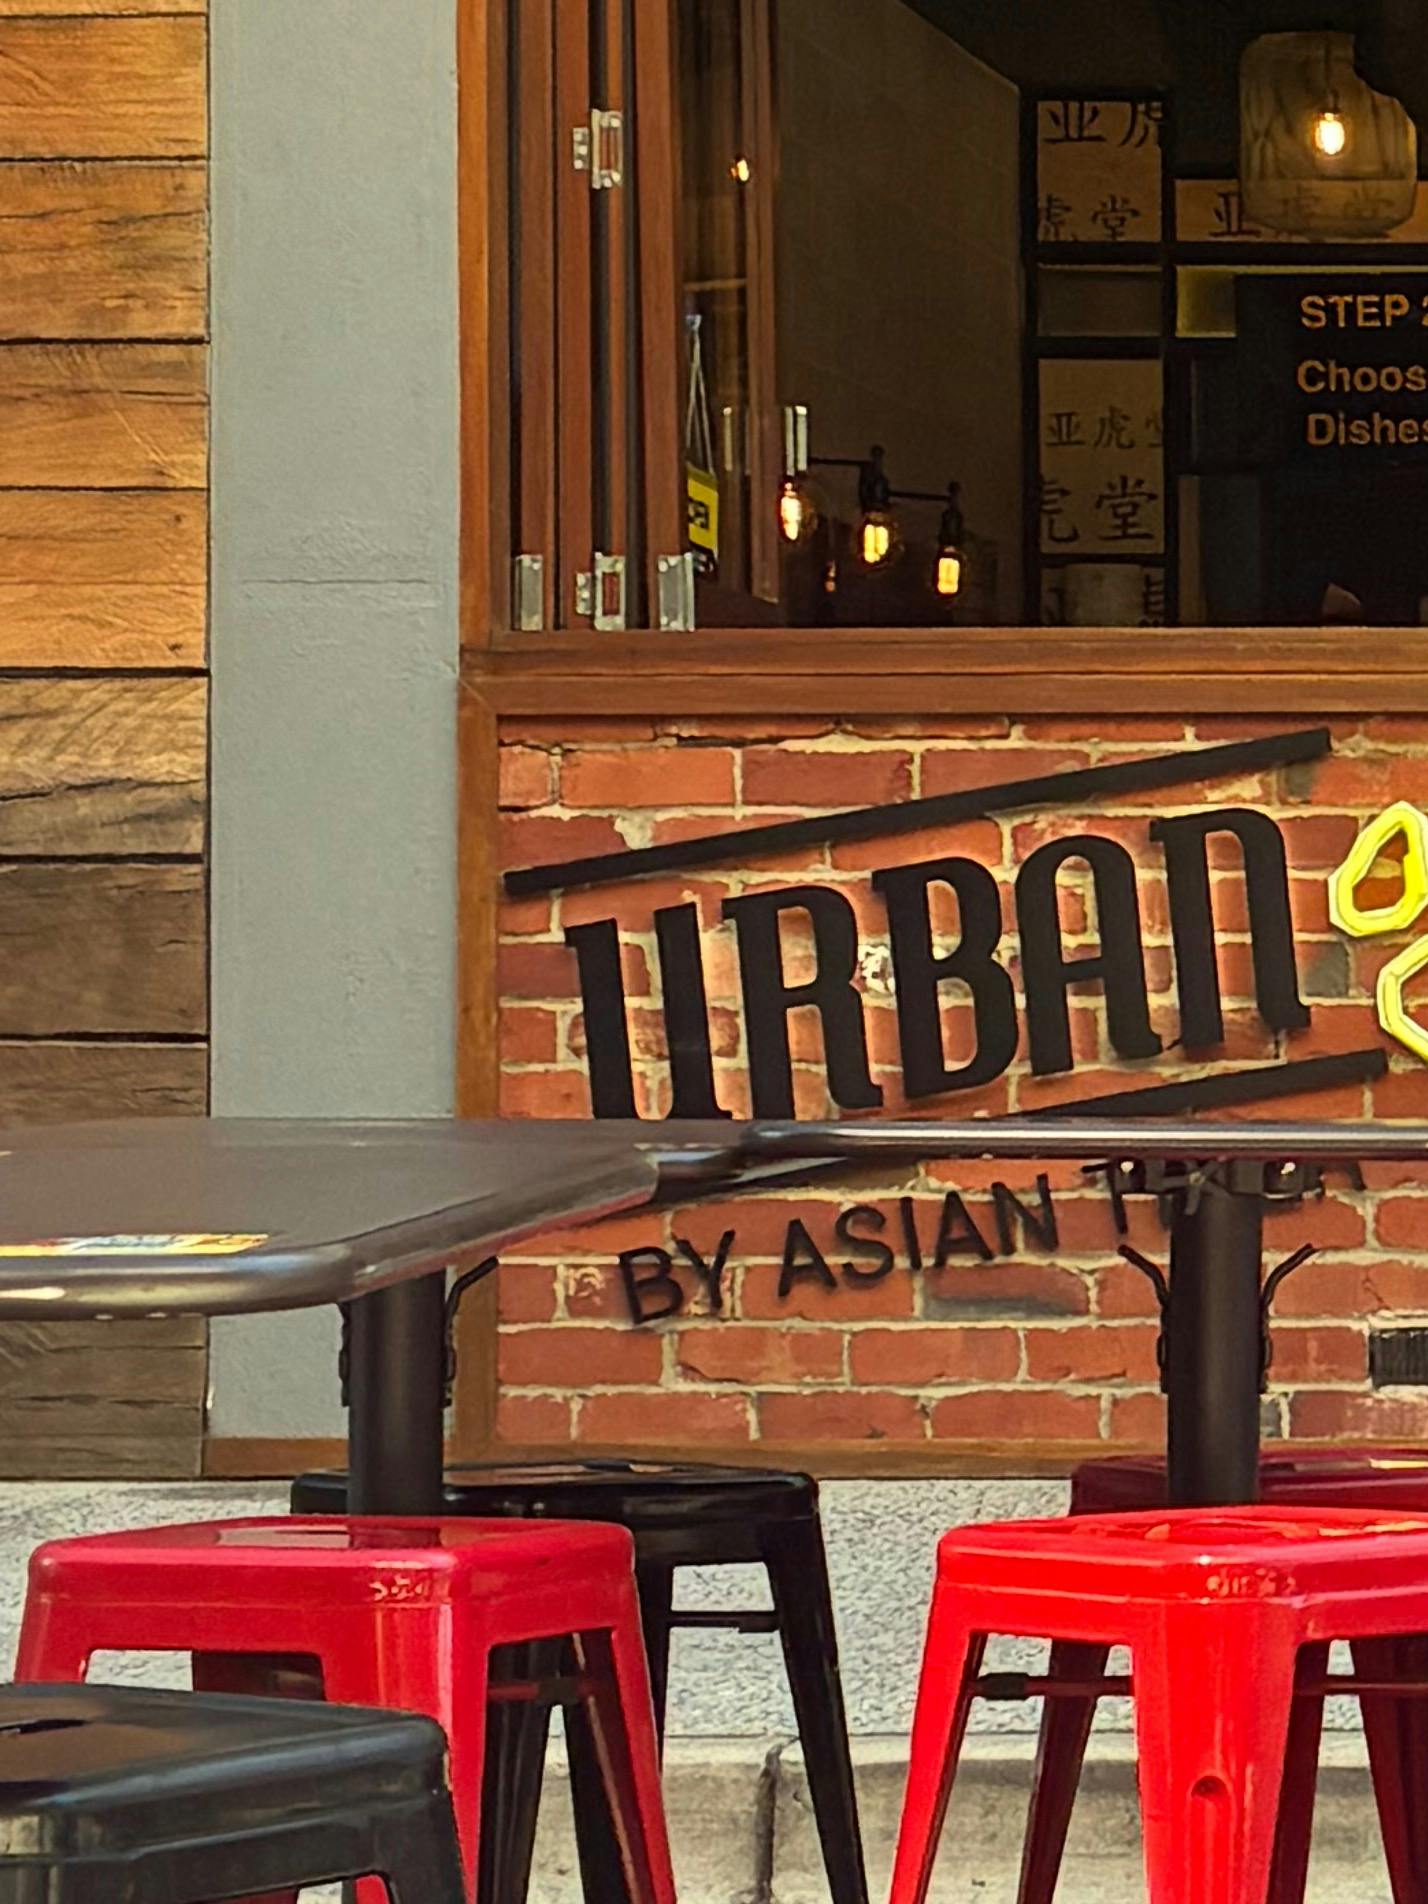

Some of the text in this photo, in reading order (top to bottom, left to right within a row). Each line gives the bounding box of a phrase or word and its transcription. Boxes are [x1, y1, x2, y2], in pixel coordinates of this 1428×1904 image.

[1300, 293, 1411, 330] STEP
[562, 806, 1312, 1122] URBAN
[615, 1226, 736, 1329] BY
[776, 1171, 1062, 1298] ASIAN
